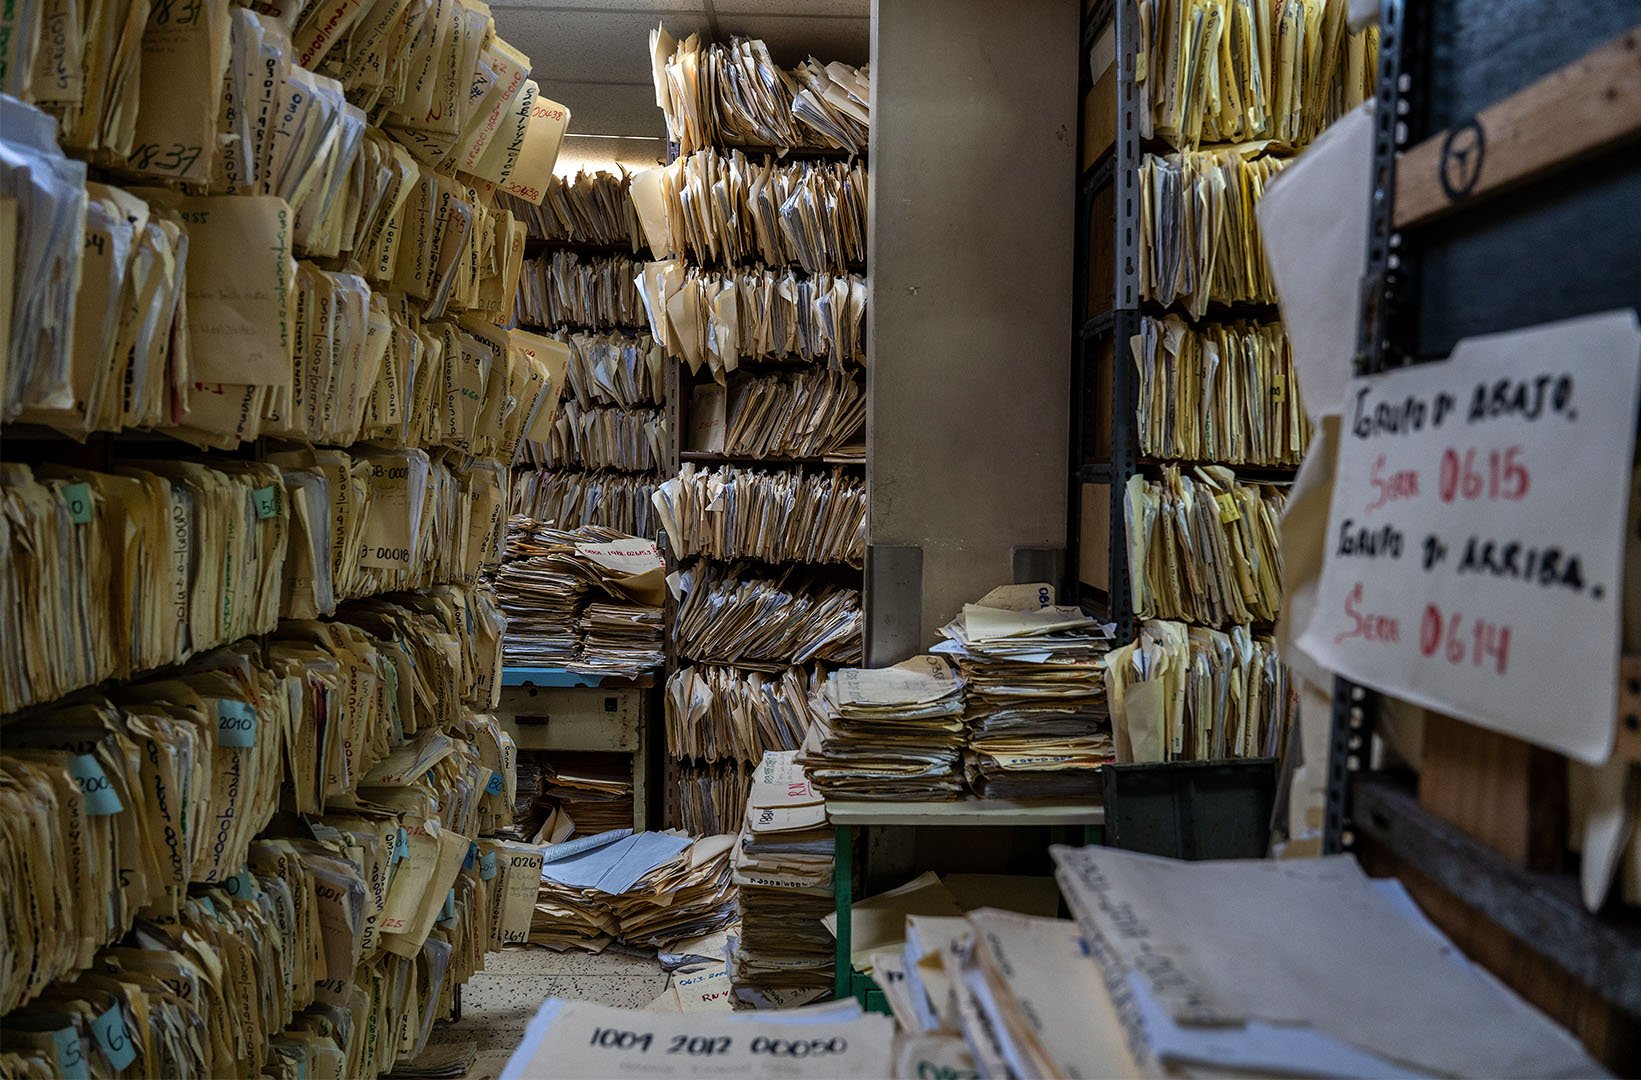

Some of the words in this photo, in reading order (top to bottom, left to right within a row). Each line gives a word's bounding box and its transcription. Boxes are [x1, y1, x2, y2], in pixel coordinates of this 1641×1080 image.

[1439, 446, 1531, 505] 0615
[1419, 602, 1511, 675] 0614
[218, 716, 253, 731] 2010
[590, 1027, 654, 1053] 1009
[669, 1034, 733, 1058] 2012
